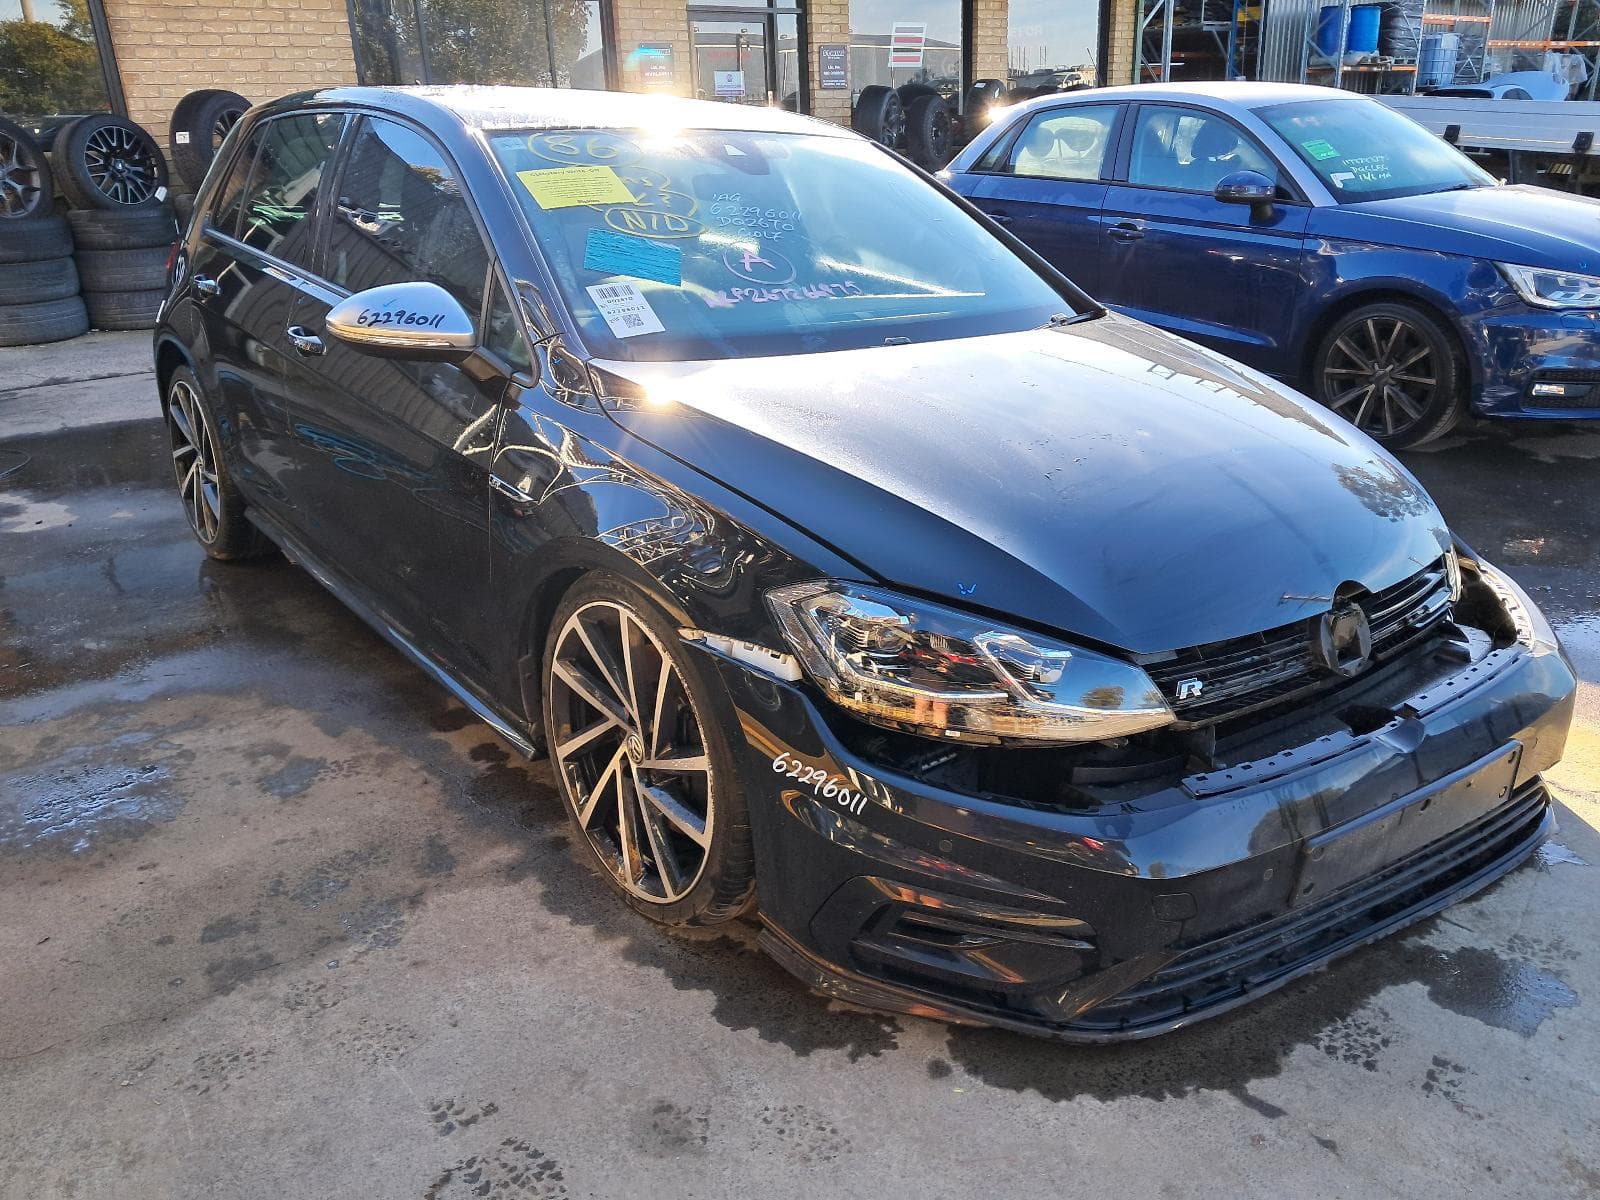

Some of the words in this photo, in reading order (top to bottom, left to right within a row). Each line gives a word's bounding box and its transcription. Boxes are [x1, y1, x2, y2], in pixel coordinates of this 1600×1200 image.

[543, 134, 620, 159] 86
[709, 203, 801, 222] 62296011
[356, 308, 446, 329] 62296011
[1175, 677, 1203, 700] R
[772, 752, 868, 816] 62296011
